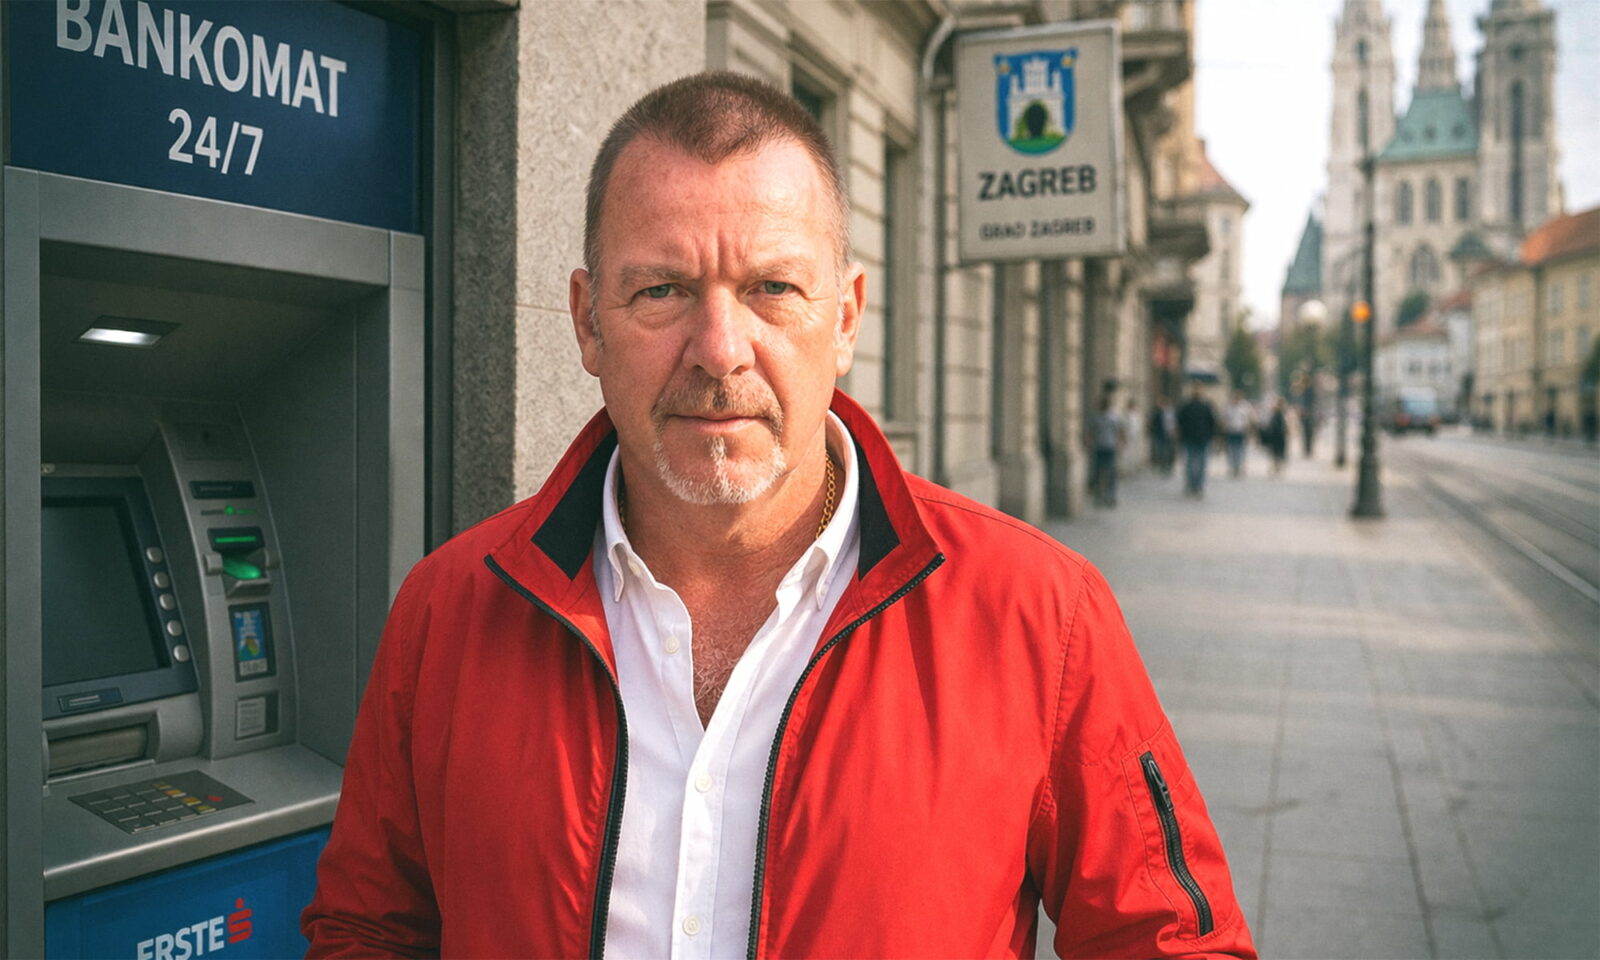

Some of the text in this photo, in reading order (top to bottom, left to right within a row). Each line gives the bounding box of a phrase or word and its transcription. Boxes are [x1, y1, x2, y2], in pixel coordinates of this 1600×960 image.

[56, 0, 347, 117] BANKOMAT
[168, 108, 263, 175] 24/7
[978, 164, 1096, 201] ZAGREB
